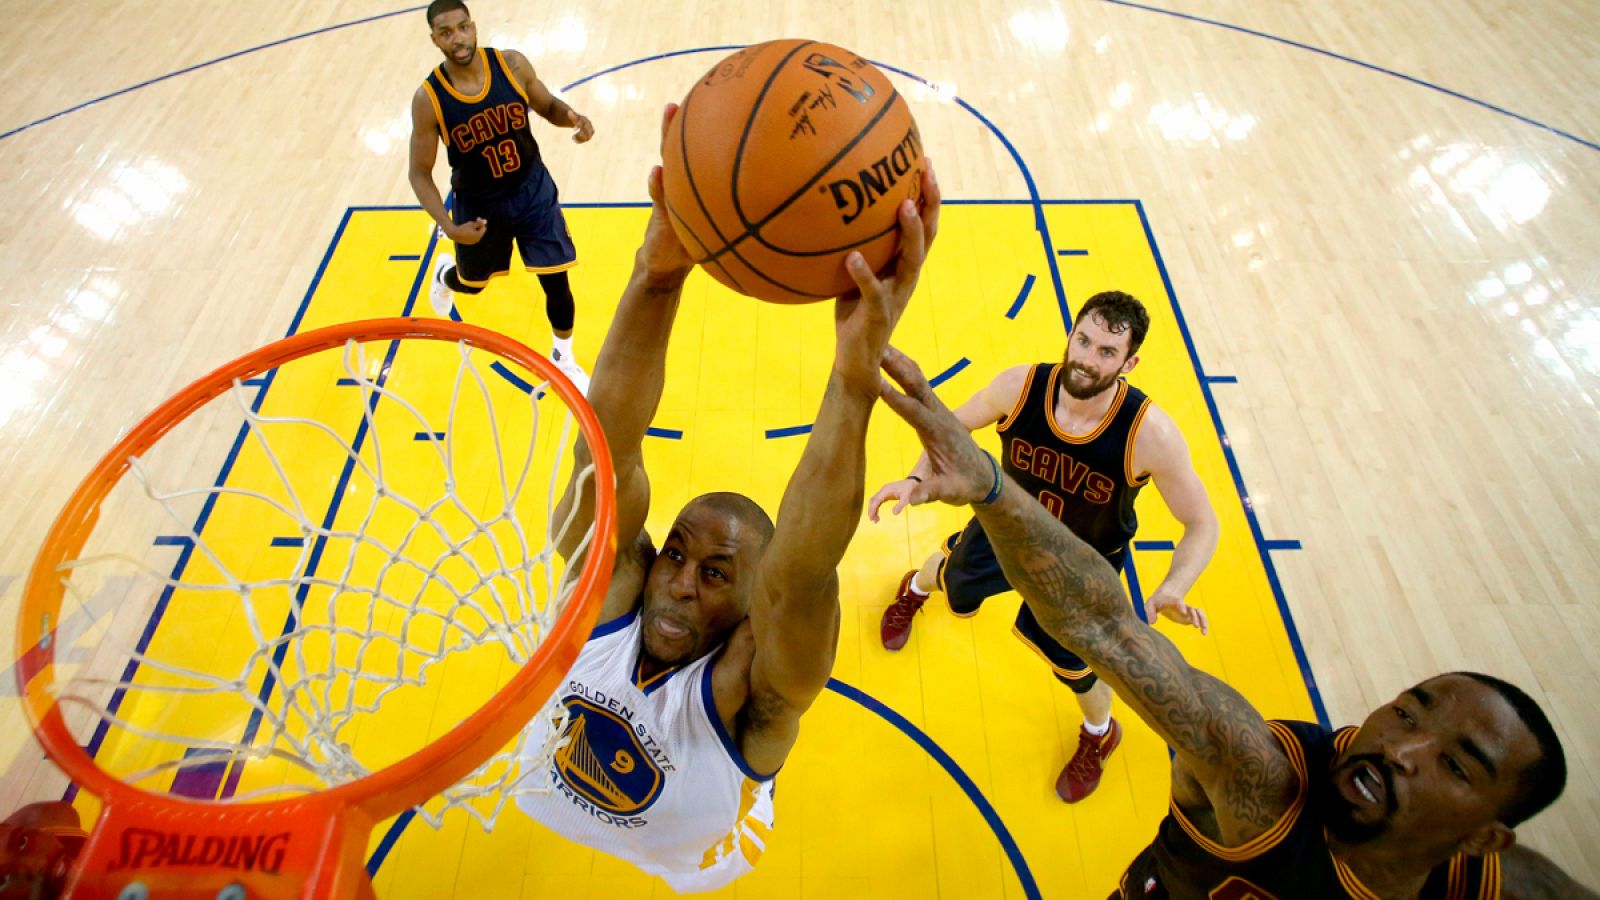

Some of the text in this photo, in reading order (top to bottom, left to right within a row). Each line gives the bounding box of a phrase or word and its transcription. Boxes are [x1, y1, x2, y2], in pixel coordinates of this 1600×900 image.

[451, 102, 527, 153] CAVS
[481, 138, 521, 178] 13
[1010, 437, 1115, 505] CAVS
[569, 680, 676, 773] GOLDEN STATE
[610, 749, 635, 775] 9
[549, 768, 648, 829] ARRIORS
[105, 827, 292, 876] SPALDING
